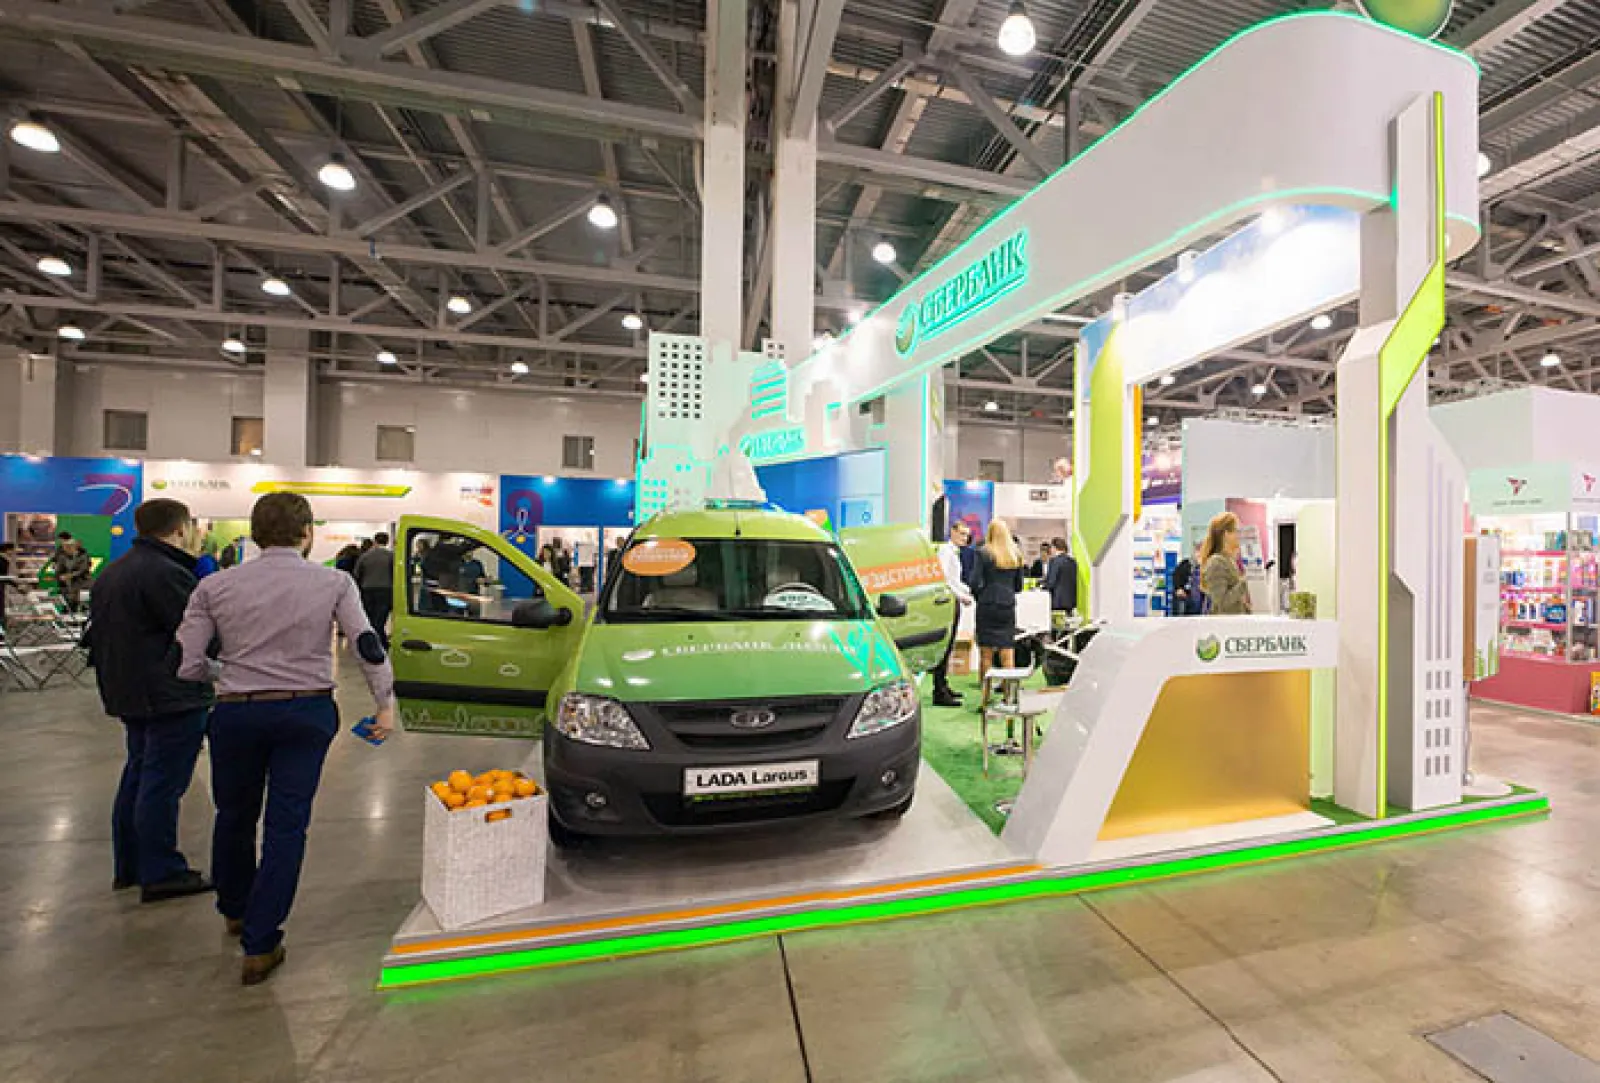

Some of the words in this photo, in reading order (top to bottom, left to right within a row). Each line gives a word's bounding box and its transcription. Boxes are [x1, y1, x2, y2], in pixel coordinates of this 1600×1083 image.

[919, 230, 1026, 329] СБЕРБАНК
[1224, 634, 1306, 653] СБЕРБАНК
[696, 771, 747, 787] LADA
[752, 769, 808, 785] Largus
